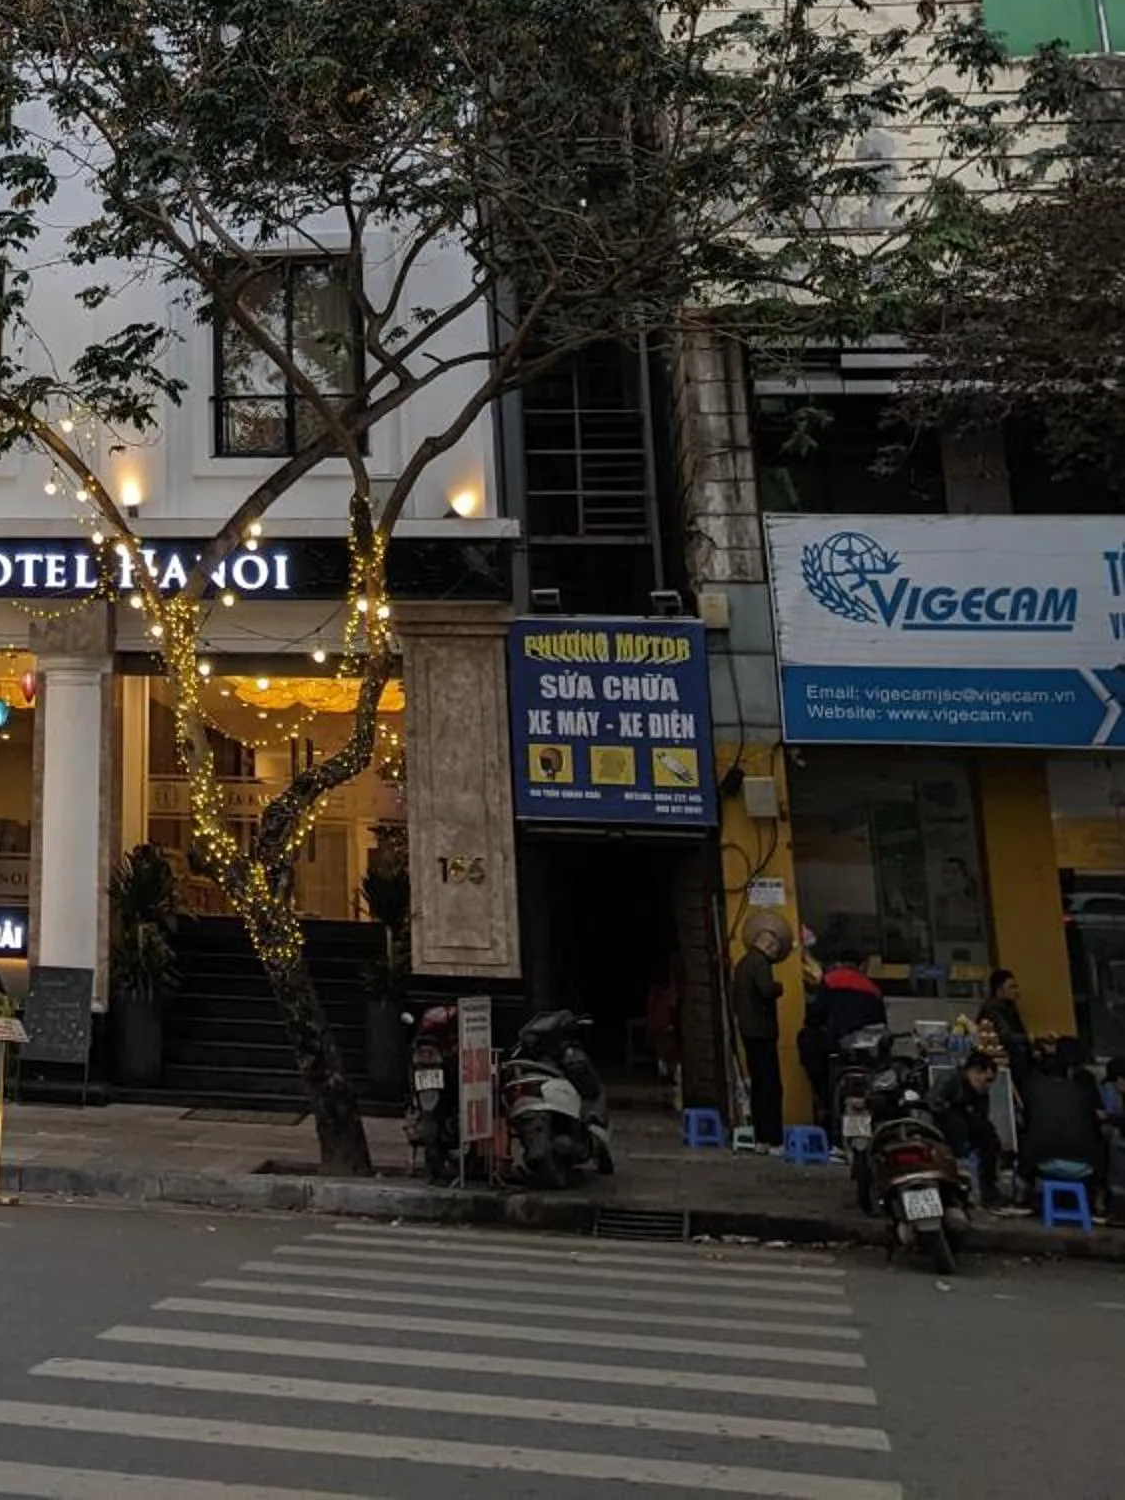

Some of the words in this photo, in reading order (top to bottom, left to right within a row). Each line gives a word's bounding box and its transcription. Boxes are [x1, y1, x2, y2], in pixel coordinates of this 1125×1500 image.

[866, 577, 1077, 628] VIGECAM
[615, 632, 692, 664] MOTOR
[539, 669, 595, 700] SỬA
[602, 673, 680, 702] CHỮA
[806, 685, 859, 700] Email:
[528, 709, 552, 736] XE
[557, 707, 600, 737] MÁY
[619, 711, 644, 738] XE
[806, 702, 882, 720] Website:
[887, 703, 1034, 724] www.vigecam.vn
